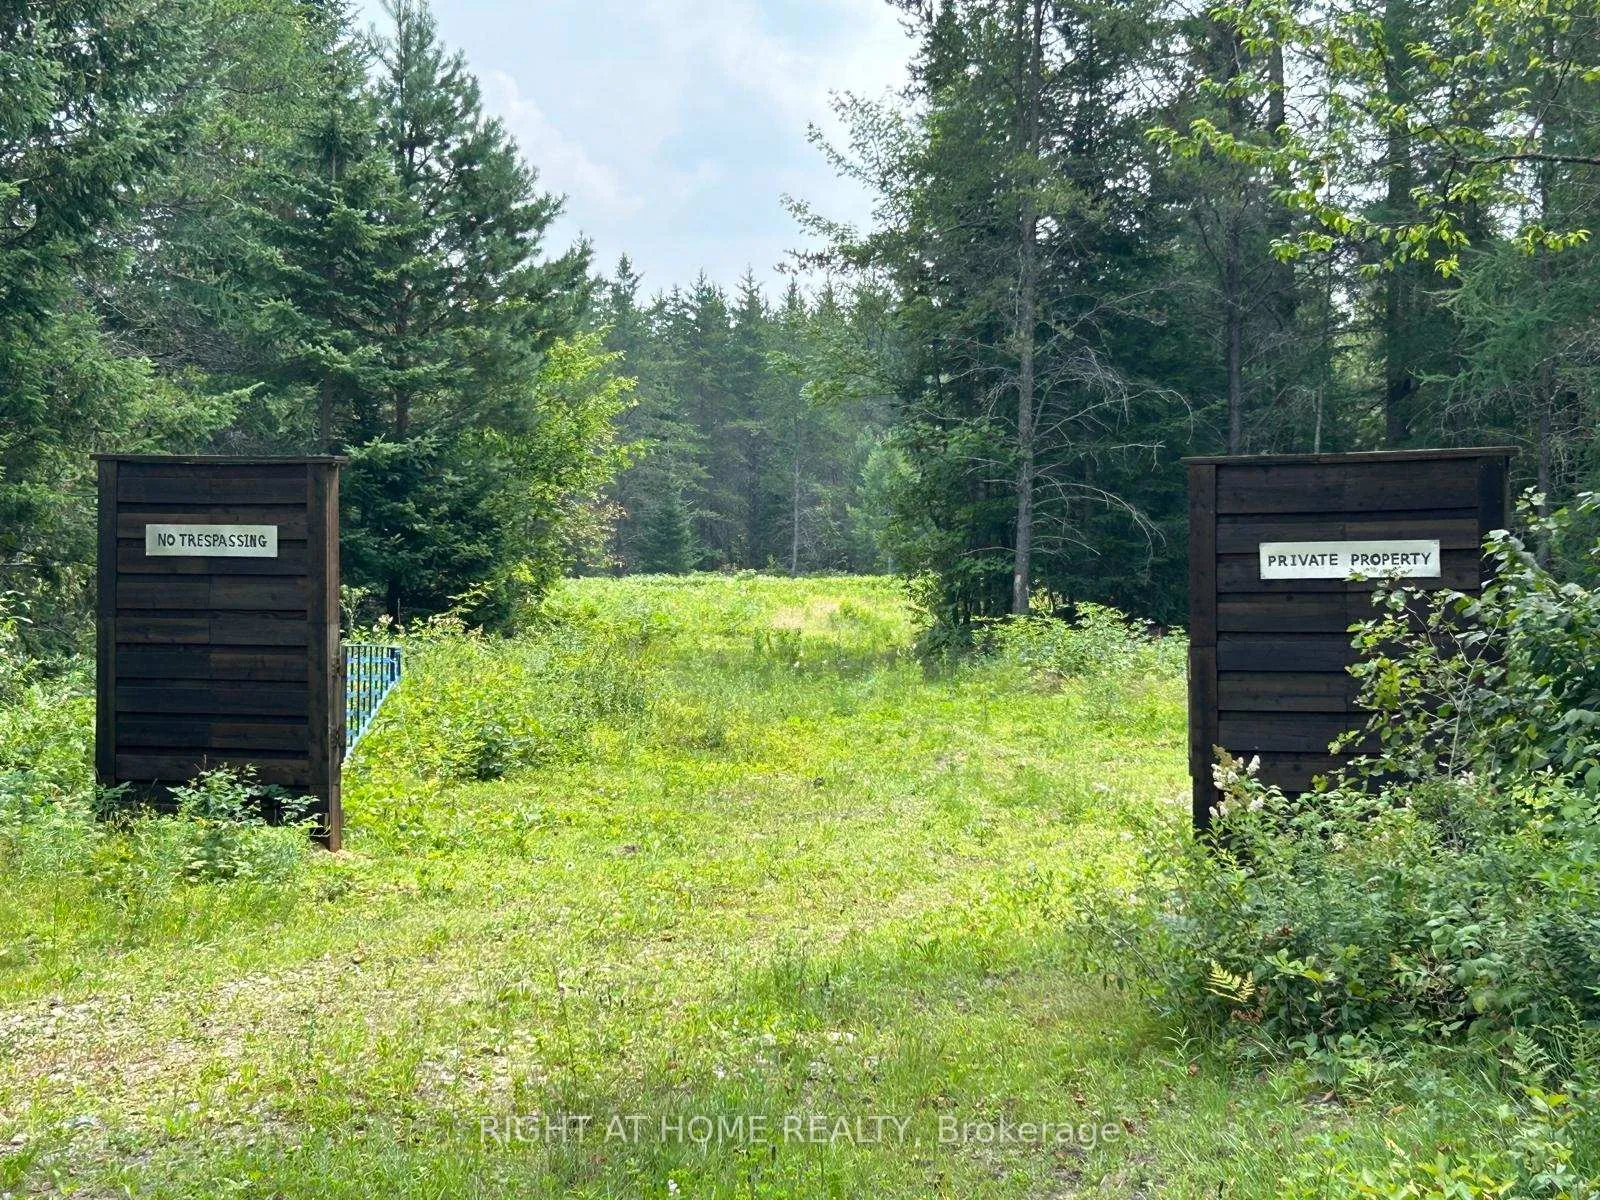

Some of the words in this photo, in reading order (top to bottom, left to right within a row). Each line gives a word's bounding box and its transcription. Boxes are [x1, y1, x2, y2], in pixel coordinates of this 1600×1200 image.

[158, 533, 176, 546] NO
[179, 533, 267, 547] TRESPASSING
[1268, 553, 1338, 566] PRIVATE
[1351, 552, 1432, 566] PROPERTY
